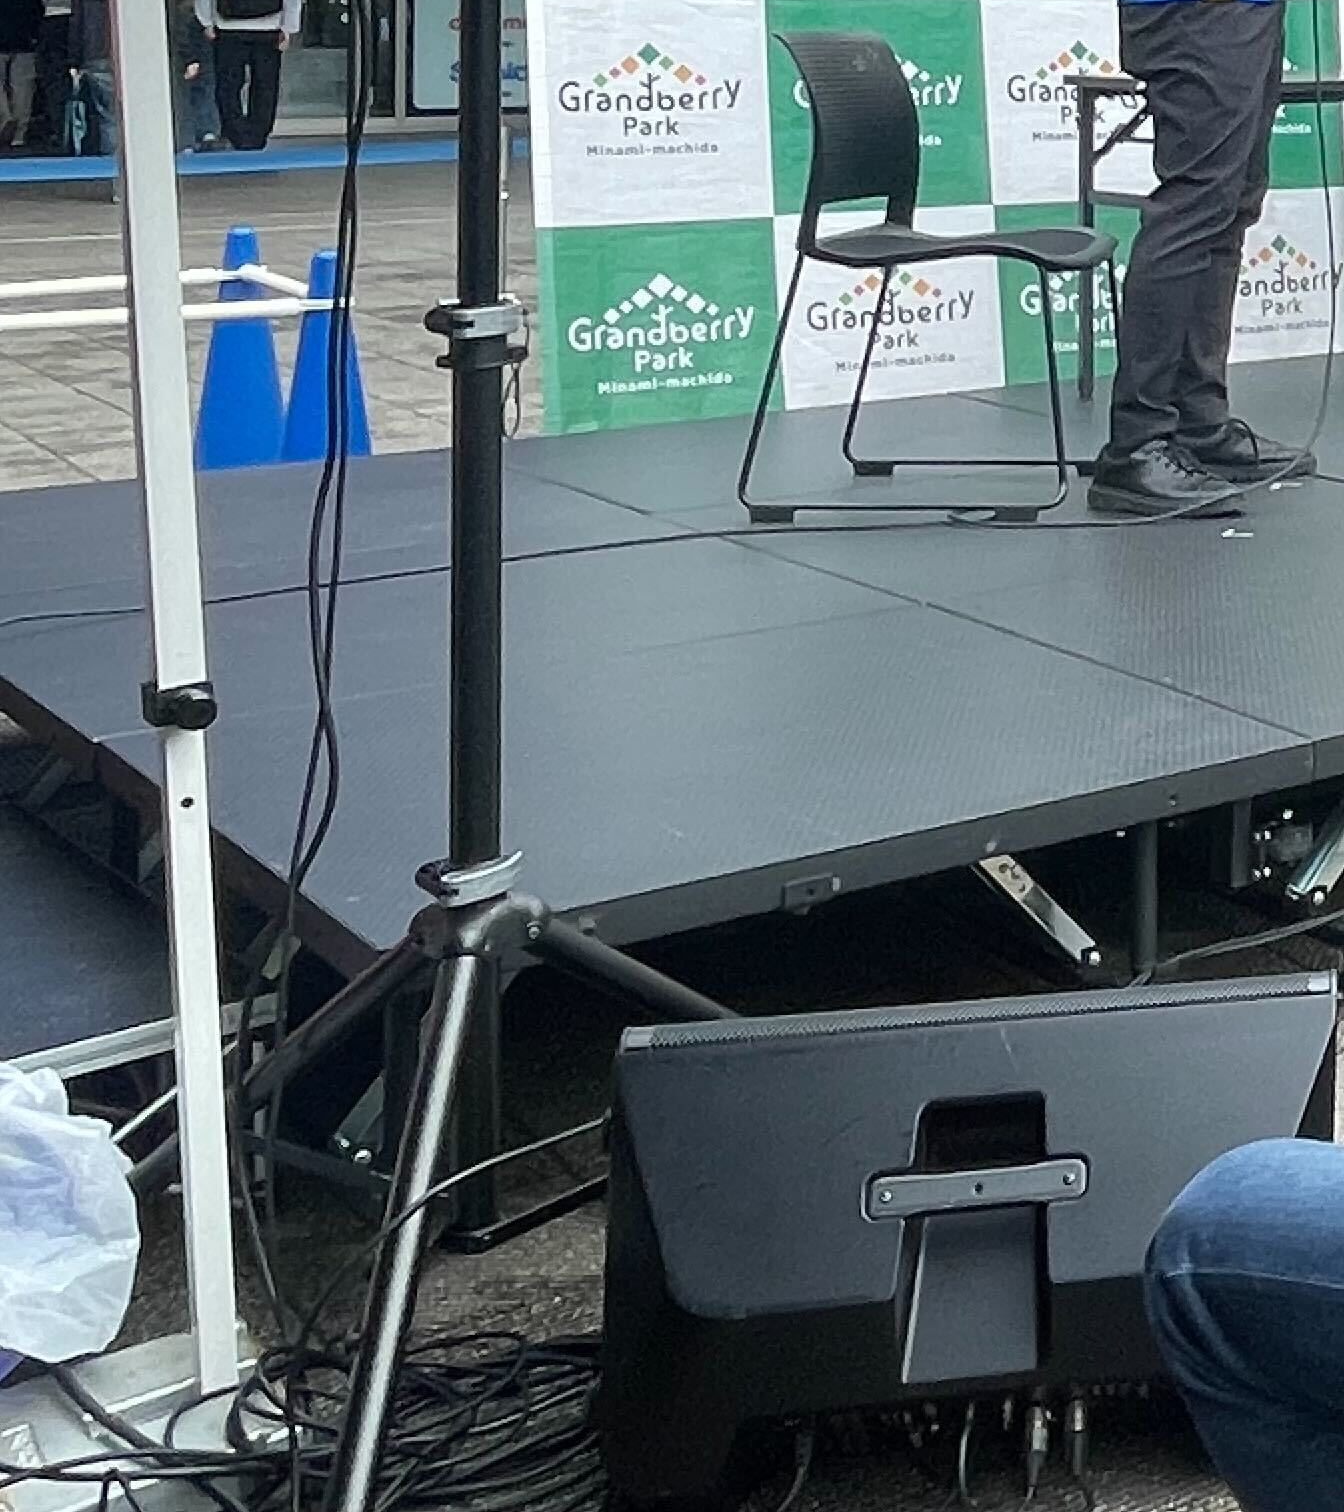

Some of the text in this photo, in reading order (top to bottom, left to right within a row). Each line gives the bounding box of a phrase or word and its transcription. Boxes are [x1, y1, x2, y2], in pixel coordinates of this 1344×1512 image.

[558, 72, 742, 113] Grandberry
[622, 115, 680, 138] Park
[586, 142, 719, 157] Minami-machida
[1240, 259, 1344, 297] andberry
[806, 288, 974, 332] Grandberry
[1262, 297, 1303, 318] Park
[568, 304, 755, 352] Grandberry
[634, 346, 694, 373] Park
[597, 371, 734, 394] Minami-machida
